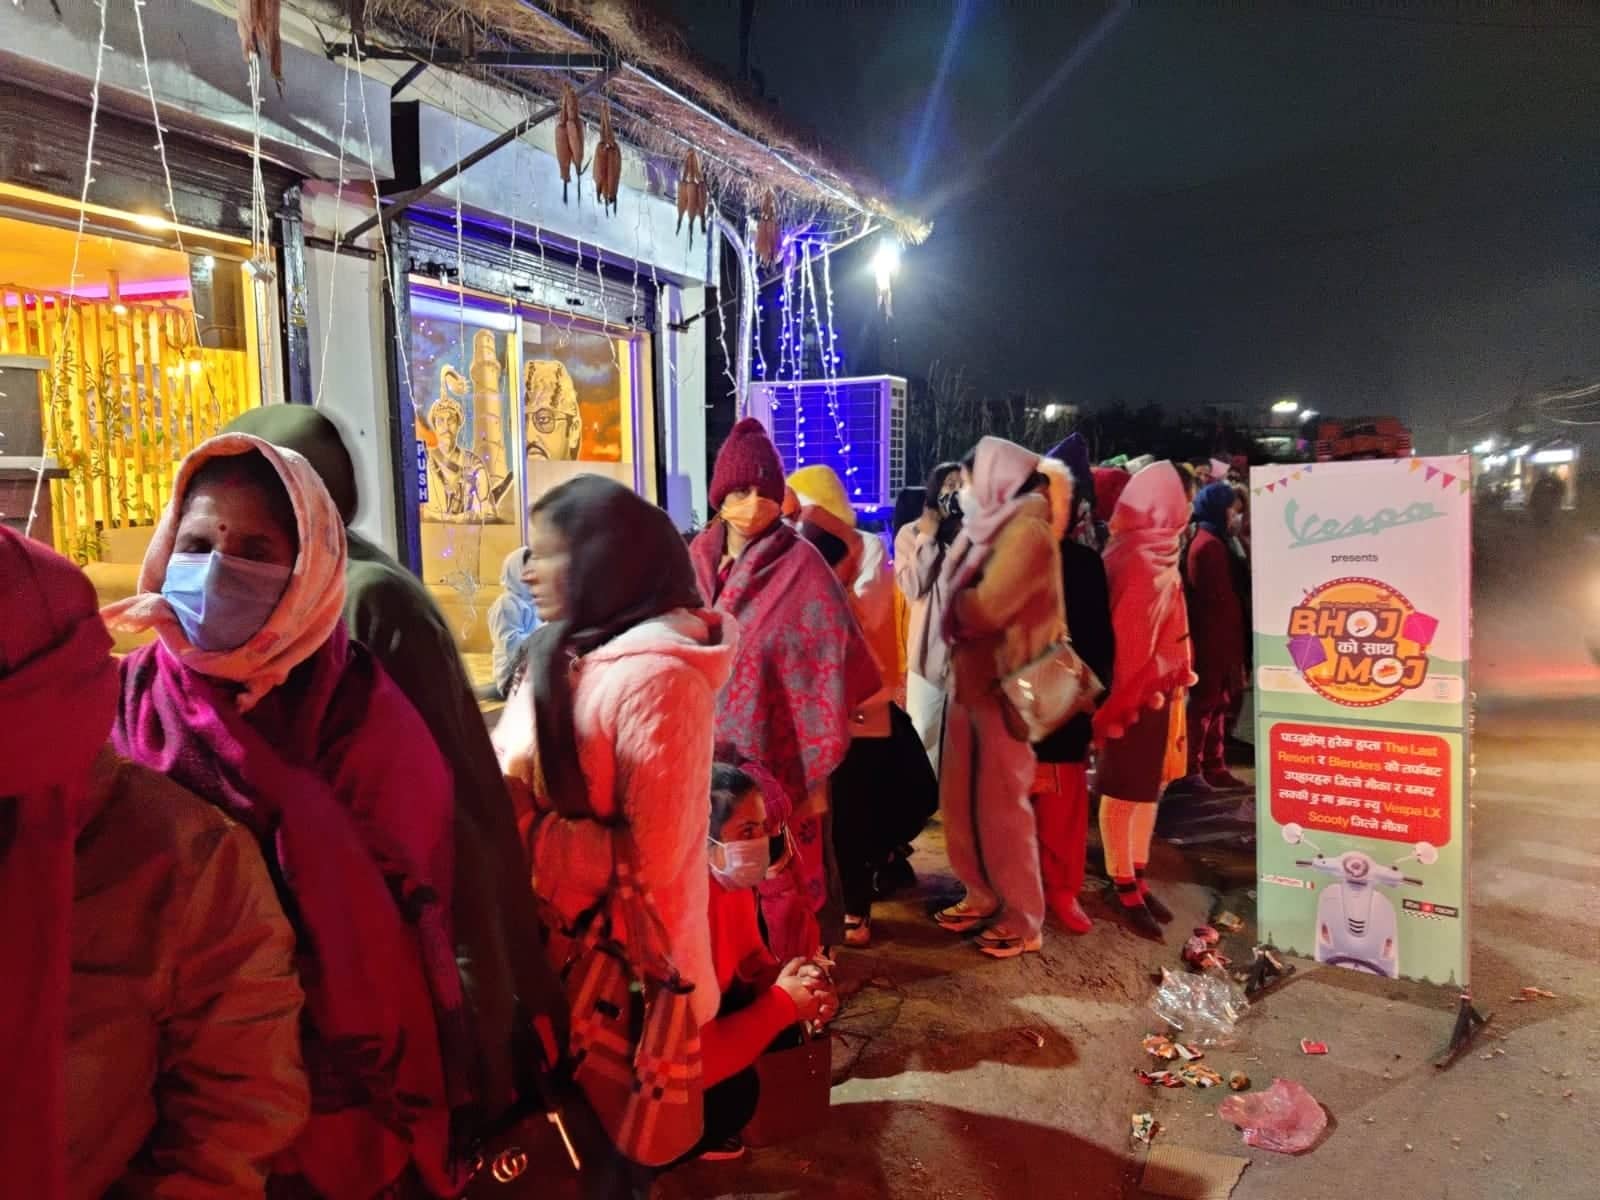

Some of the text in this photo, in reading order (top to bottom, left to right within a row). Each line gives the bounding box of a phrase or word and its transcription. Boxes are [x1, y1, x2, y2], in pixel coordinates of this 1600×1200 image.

[417, 443, 427, 500] PUSH
[1285, 498, 1448, 549] Vespa
[1331, 553, 1378, 563] presents
[1288, 607, 1402, 638] BHOJ
[1337, 638, 1395, 656] को साथ
[1336, 656, 1428, 689] MOJ
[1384, 741, 1408, 755] The
[1411, 744, 1438, 758] Last
[1278, 752, 1315, 764] Resort
[1317, 756, 1326, 766] र
[1328, 757, 1381, 771] Blenders
[1384, 759, 1401, 773] को
[1393, 783, 1402, 793] र
[1308, 811, 1350, 827] Scooty
[1384, 802, 1424, 817] Vespa
[1424, 808, 1440, 818] LX
